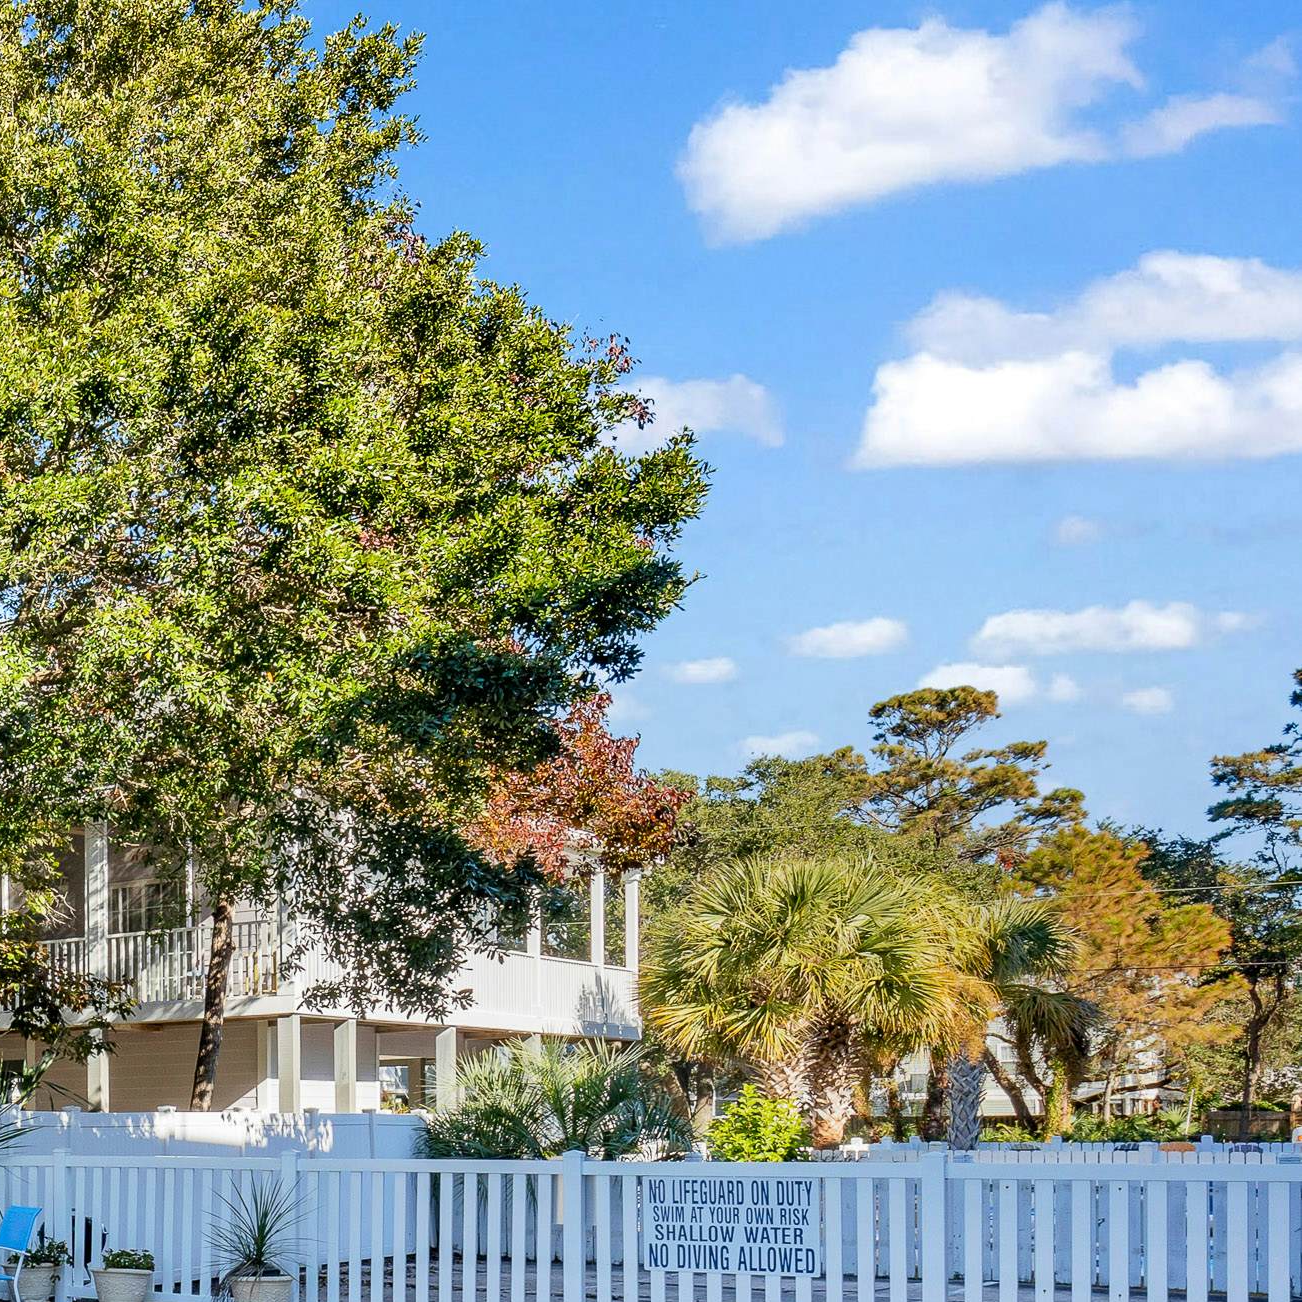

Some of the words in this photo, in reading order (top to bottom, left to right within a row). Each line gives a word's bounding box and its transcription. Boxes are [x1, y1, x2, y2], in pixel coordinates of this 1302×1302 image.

[648, 1179, 665, 1204] NO
[672, 1179, 744, 1206] LIFEGUARD
[751, 1180, 770, 1206] ON
[776, 1180, 813, 1206] DUTY
[653, 1206, 684, 1223] SWIM
[690, 1207, 704, 1223] AT
[709, 1207, 740, 1225] YOUR
[746, 1208, 774, 1225] OWN
[780, 1208, 810, 1226] RISK
[655, 1225, 735, 1243] SHALLOW
[745, 1227, 804, 1245] WATER
[648, 1243, 669, 1268] NO
[677, 1244, 730, 1271] DIVING
[737, 1246, 816, 1274] ALLOWED
